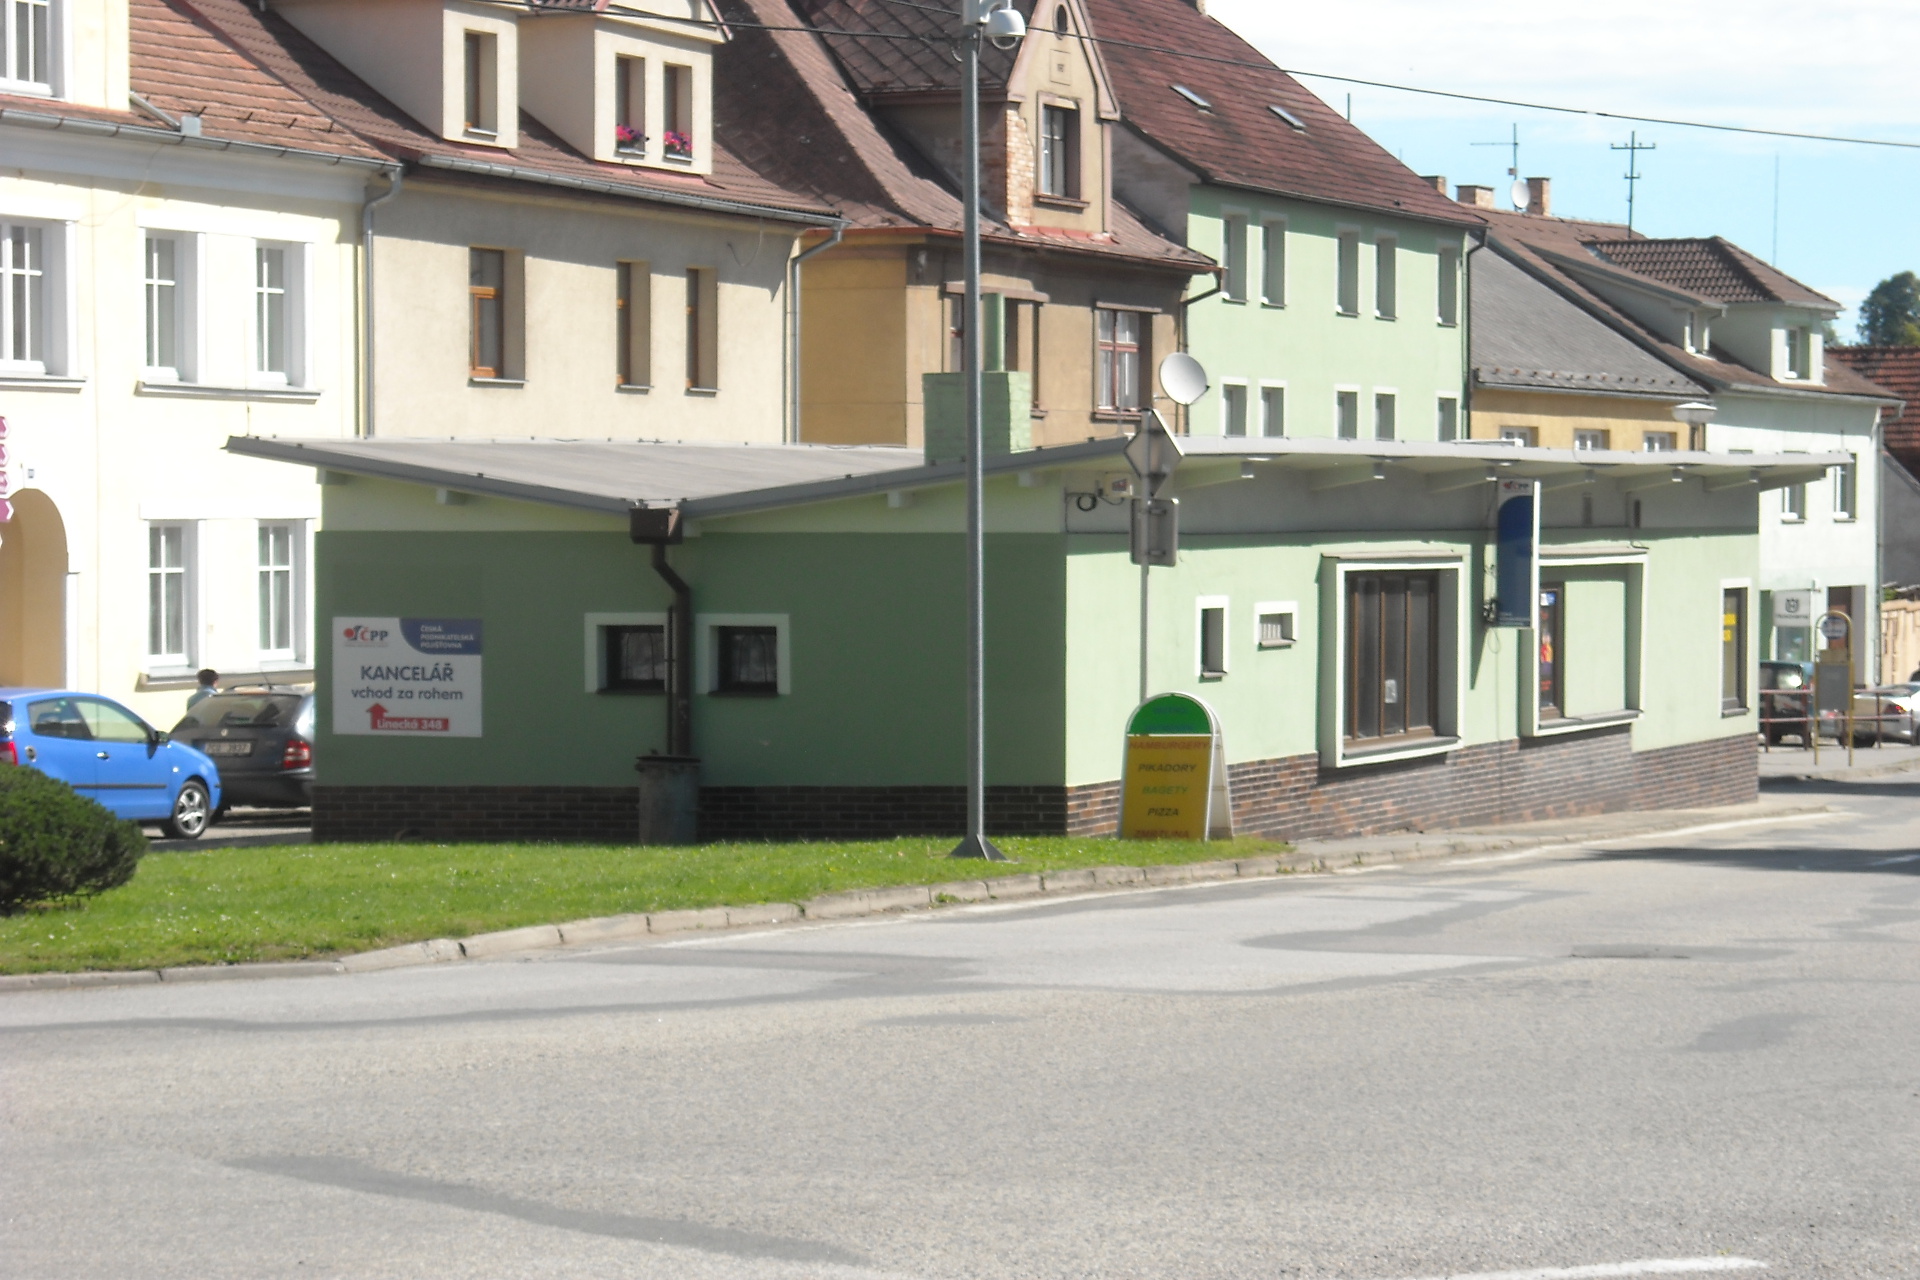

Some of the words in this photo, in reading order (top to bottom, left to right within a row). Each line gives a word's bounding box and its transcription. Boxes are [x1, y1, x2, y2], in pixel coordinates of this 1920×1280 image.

[360, 627, 388, 641] ČPP
[360, 662, 454, 682] KANCELÁŘ
[351, 686, 393, 699] vchod
[397, 690, 413, 699] za
[418, 688, 463, 700] rohem
[421, 719, 442, 730] 348
[1129, 741, 1209, 750] HAMBURGERY
[1138, 763, 1197, 772] PIKADORY
[1142, 786, 1188, 795] BAGETY
[1148, 808, 1179, 816] PIZZA
